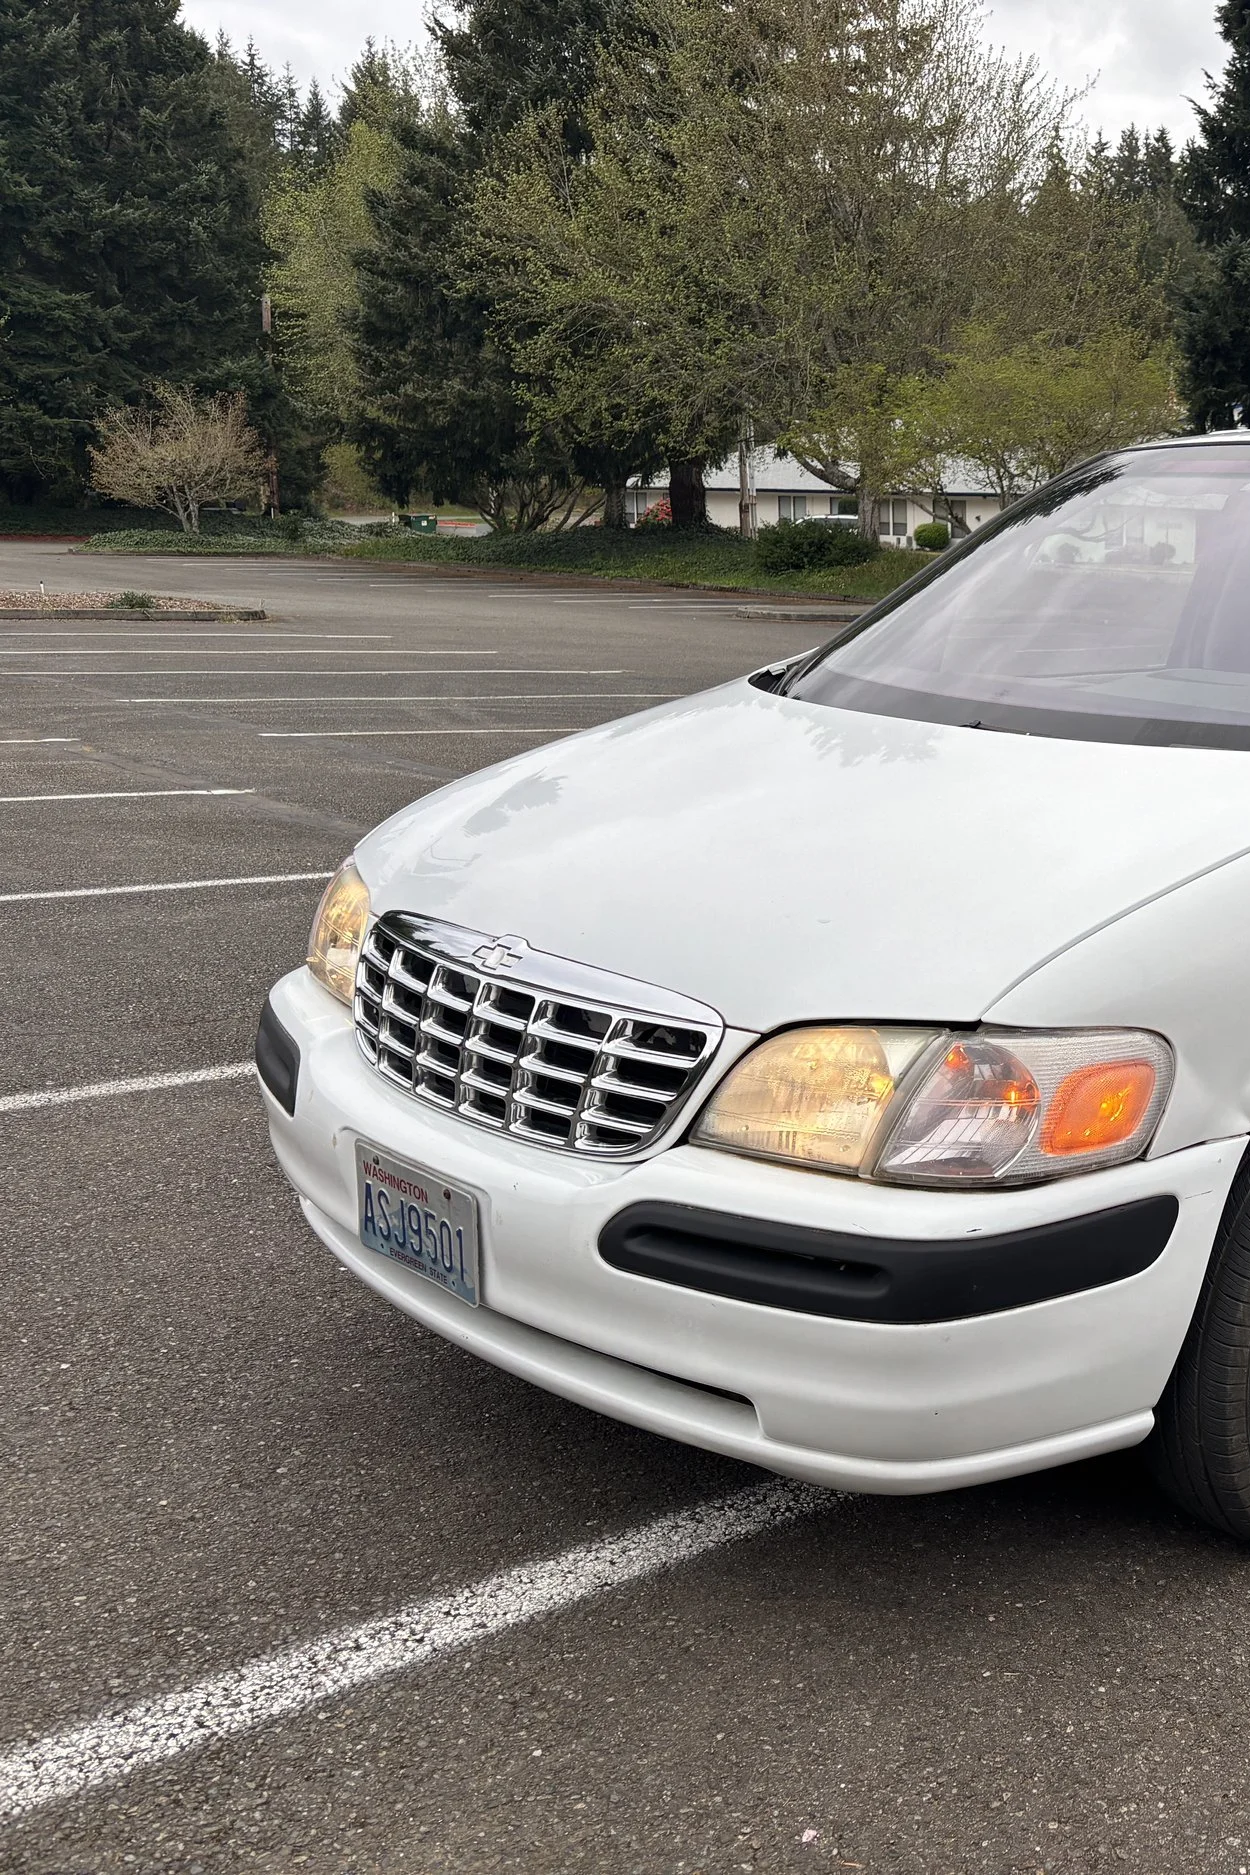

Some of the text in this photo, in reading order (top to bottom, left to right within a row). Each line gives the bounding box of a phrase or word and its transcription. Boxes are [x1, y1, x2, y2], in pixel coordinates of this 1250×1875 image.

[363, 1160, 428, 1204] WASHINGTON
[364, 1181, 465, 1282] ASJ9501
[389, 1248, 448, 1284] EVERGREEN STATE
